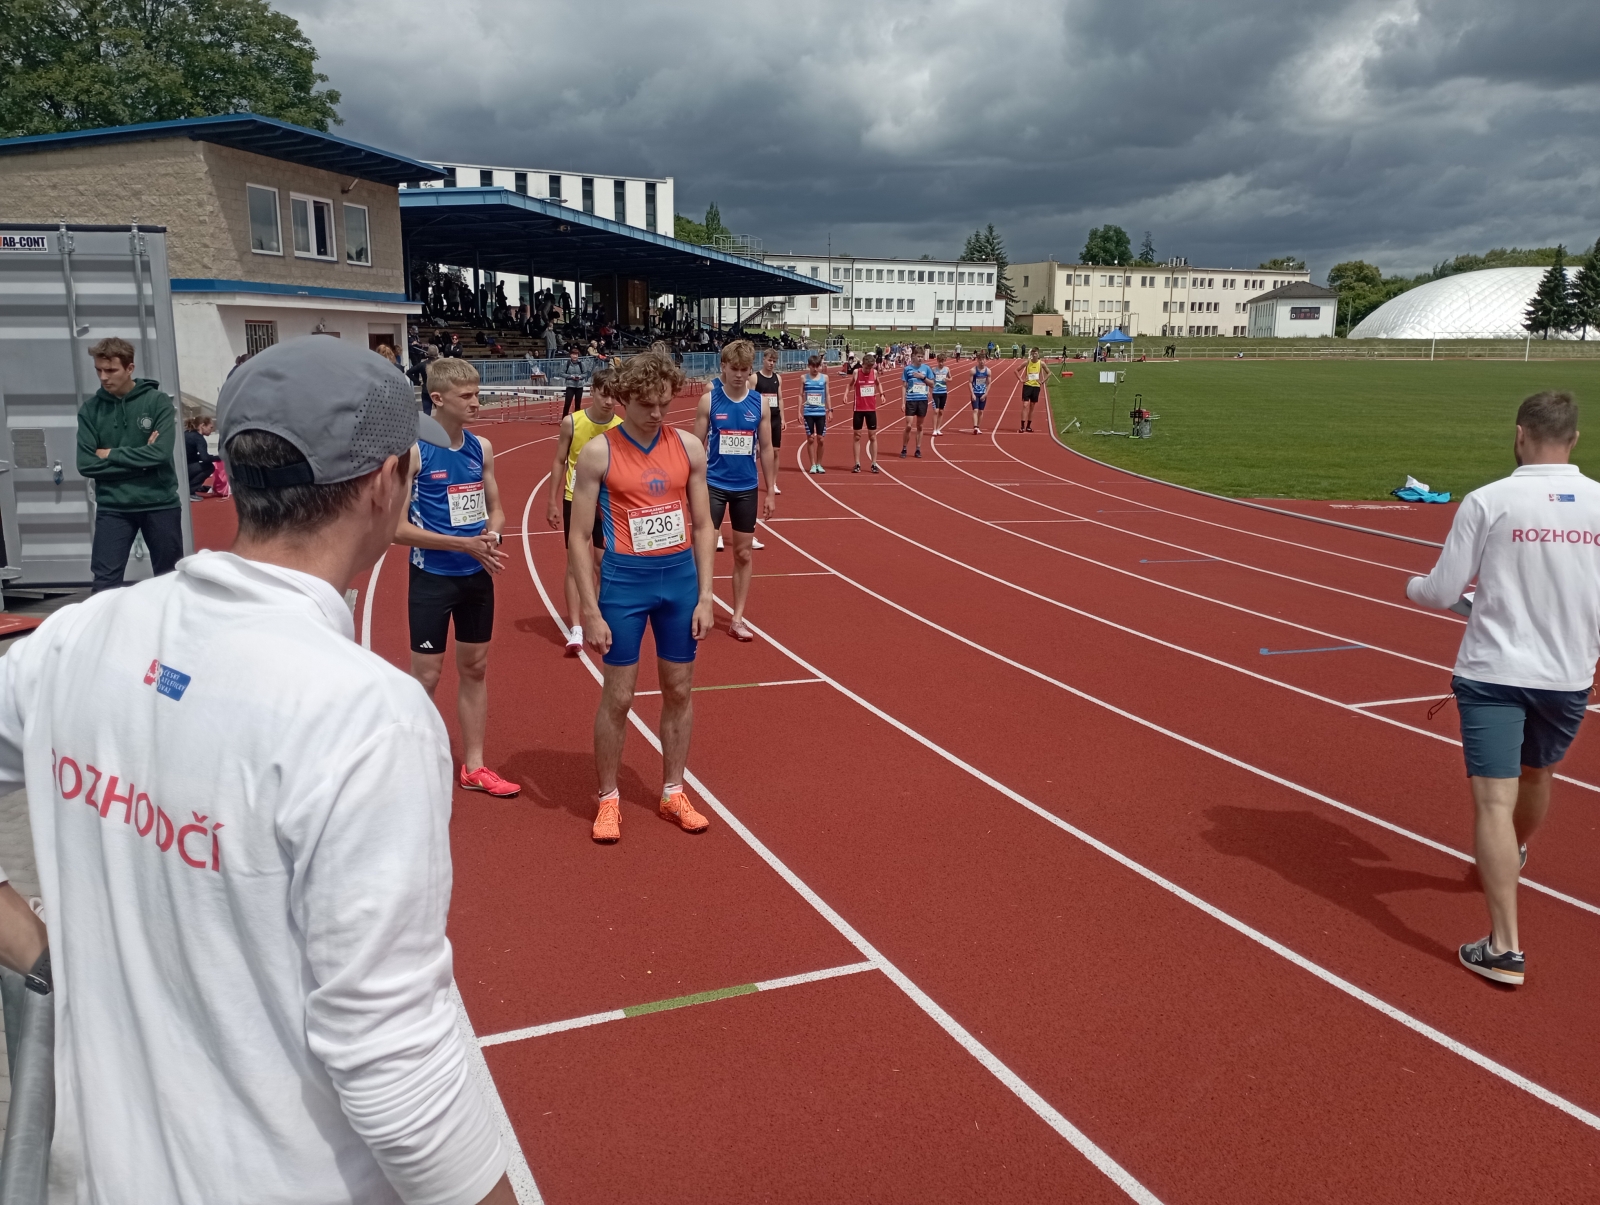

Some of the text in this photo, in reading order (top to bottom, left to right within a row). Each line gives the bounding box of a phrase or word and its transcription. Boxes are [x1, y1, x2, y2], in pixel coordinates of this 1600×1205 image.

[3, 236, 46, 248] AB-CONT
[728, 436, 745, 447] 308
[461, 493, 481, 510] 257
[645, 515, 673, 535] 236
